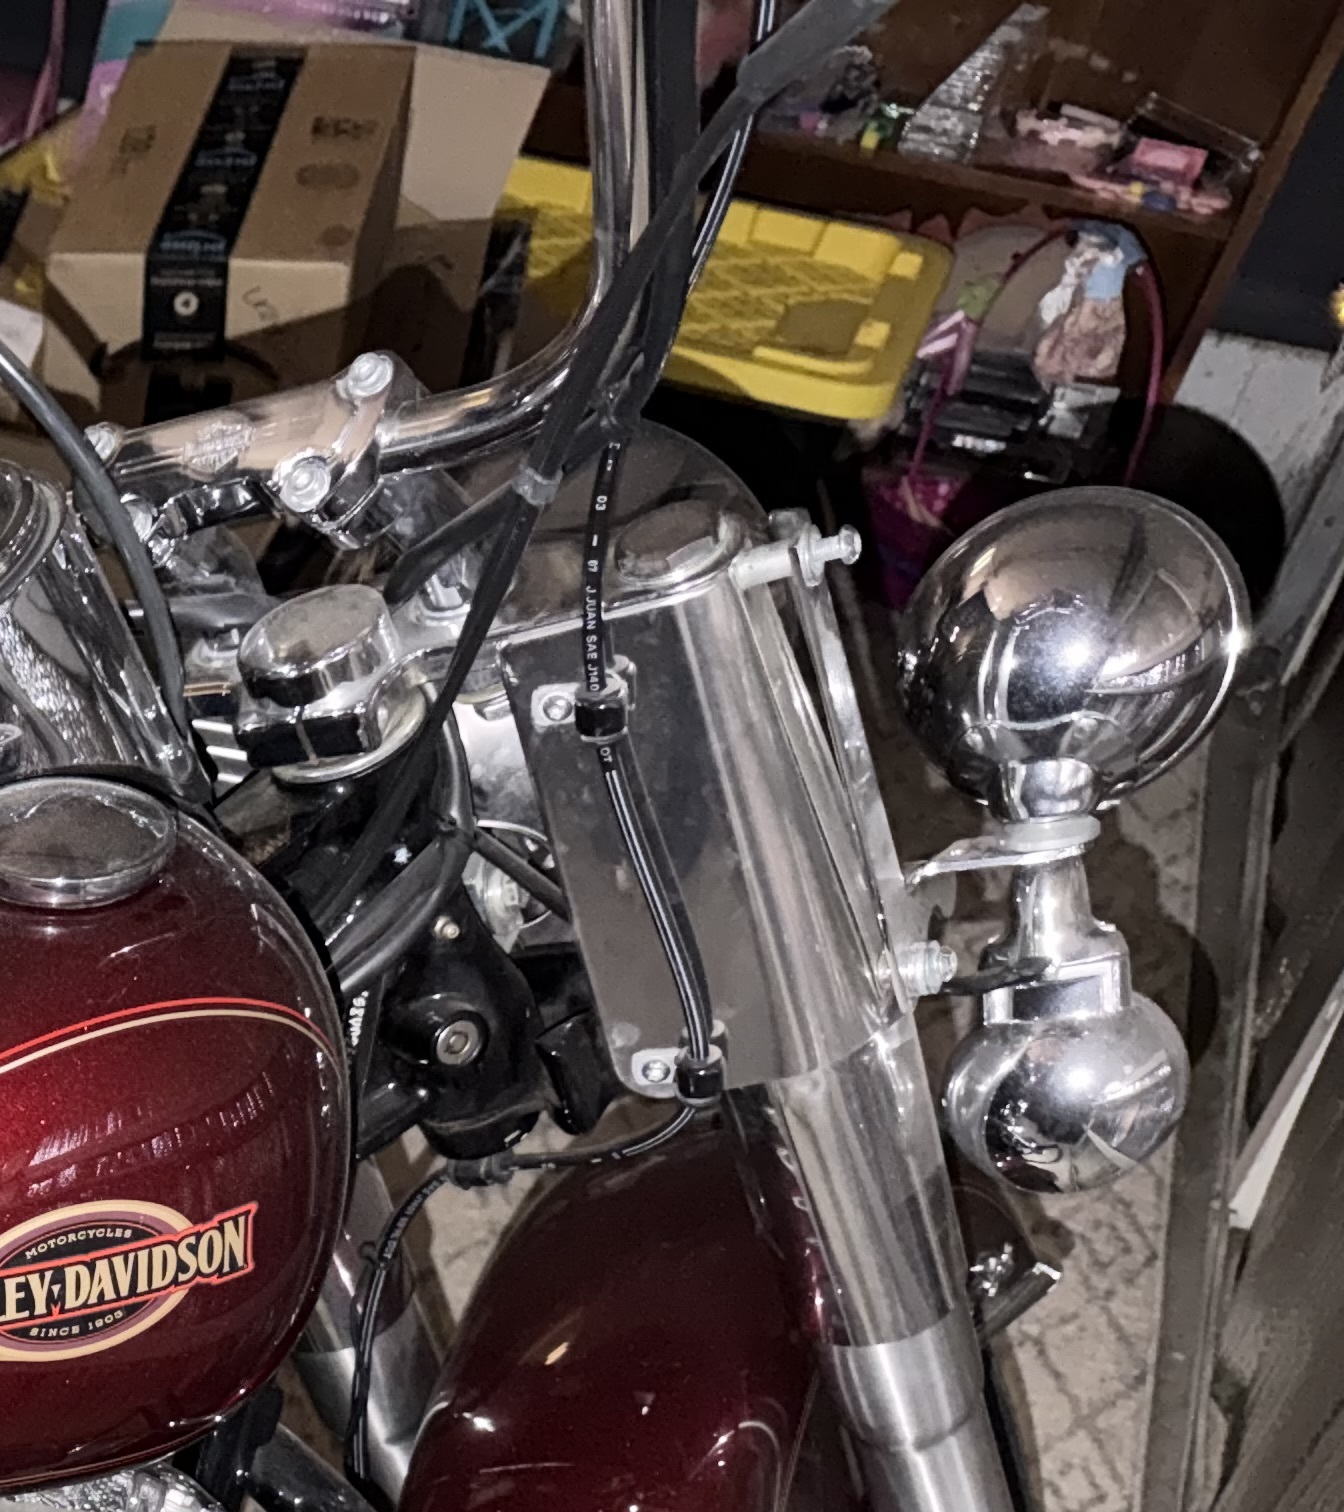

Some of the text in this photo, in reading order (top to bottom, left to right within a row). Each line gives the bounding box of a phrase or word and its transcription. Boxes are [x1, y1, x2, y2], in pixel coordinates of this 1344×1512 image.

[595, 494, 608, 512] 03
[585, 634, 599, 661] SAE
[24, 1227, 134, 1260] MOTORCYCLES
[28, 1323, 81, 1339] SINCE
